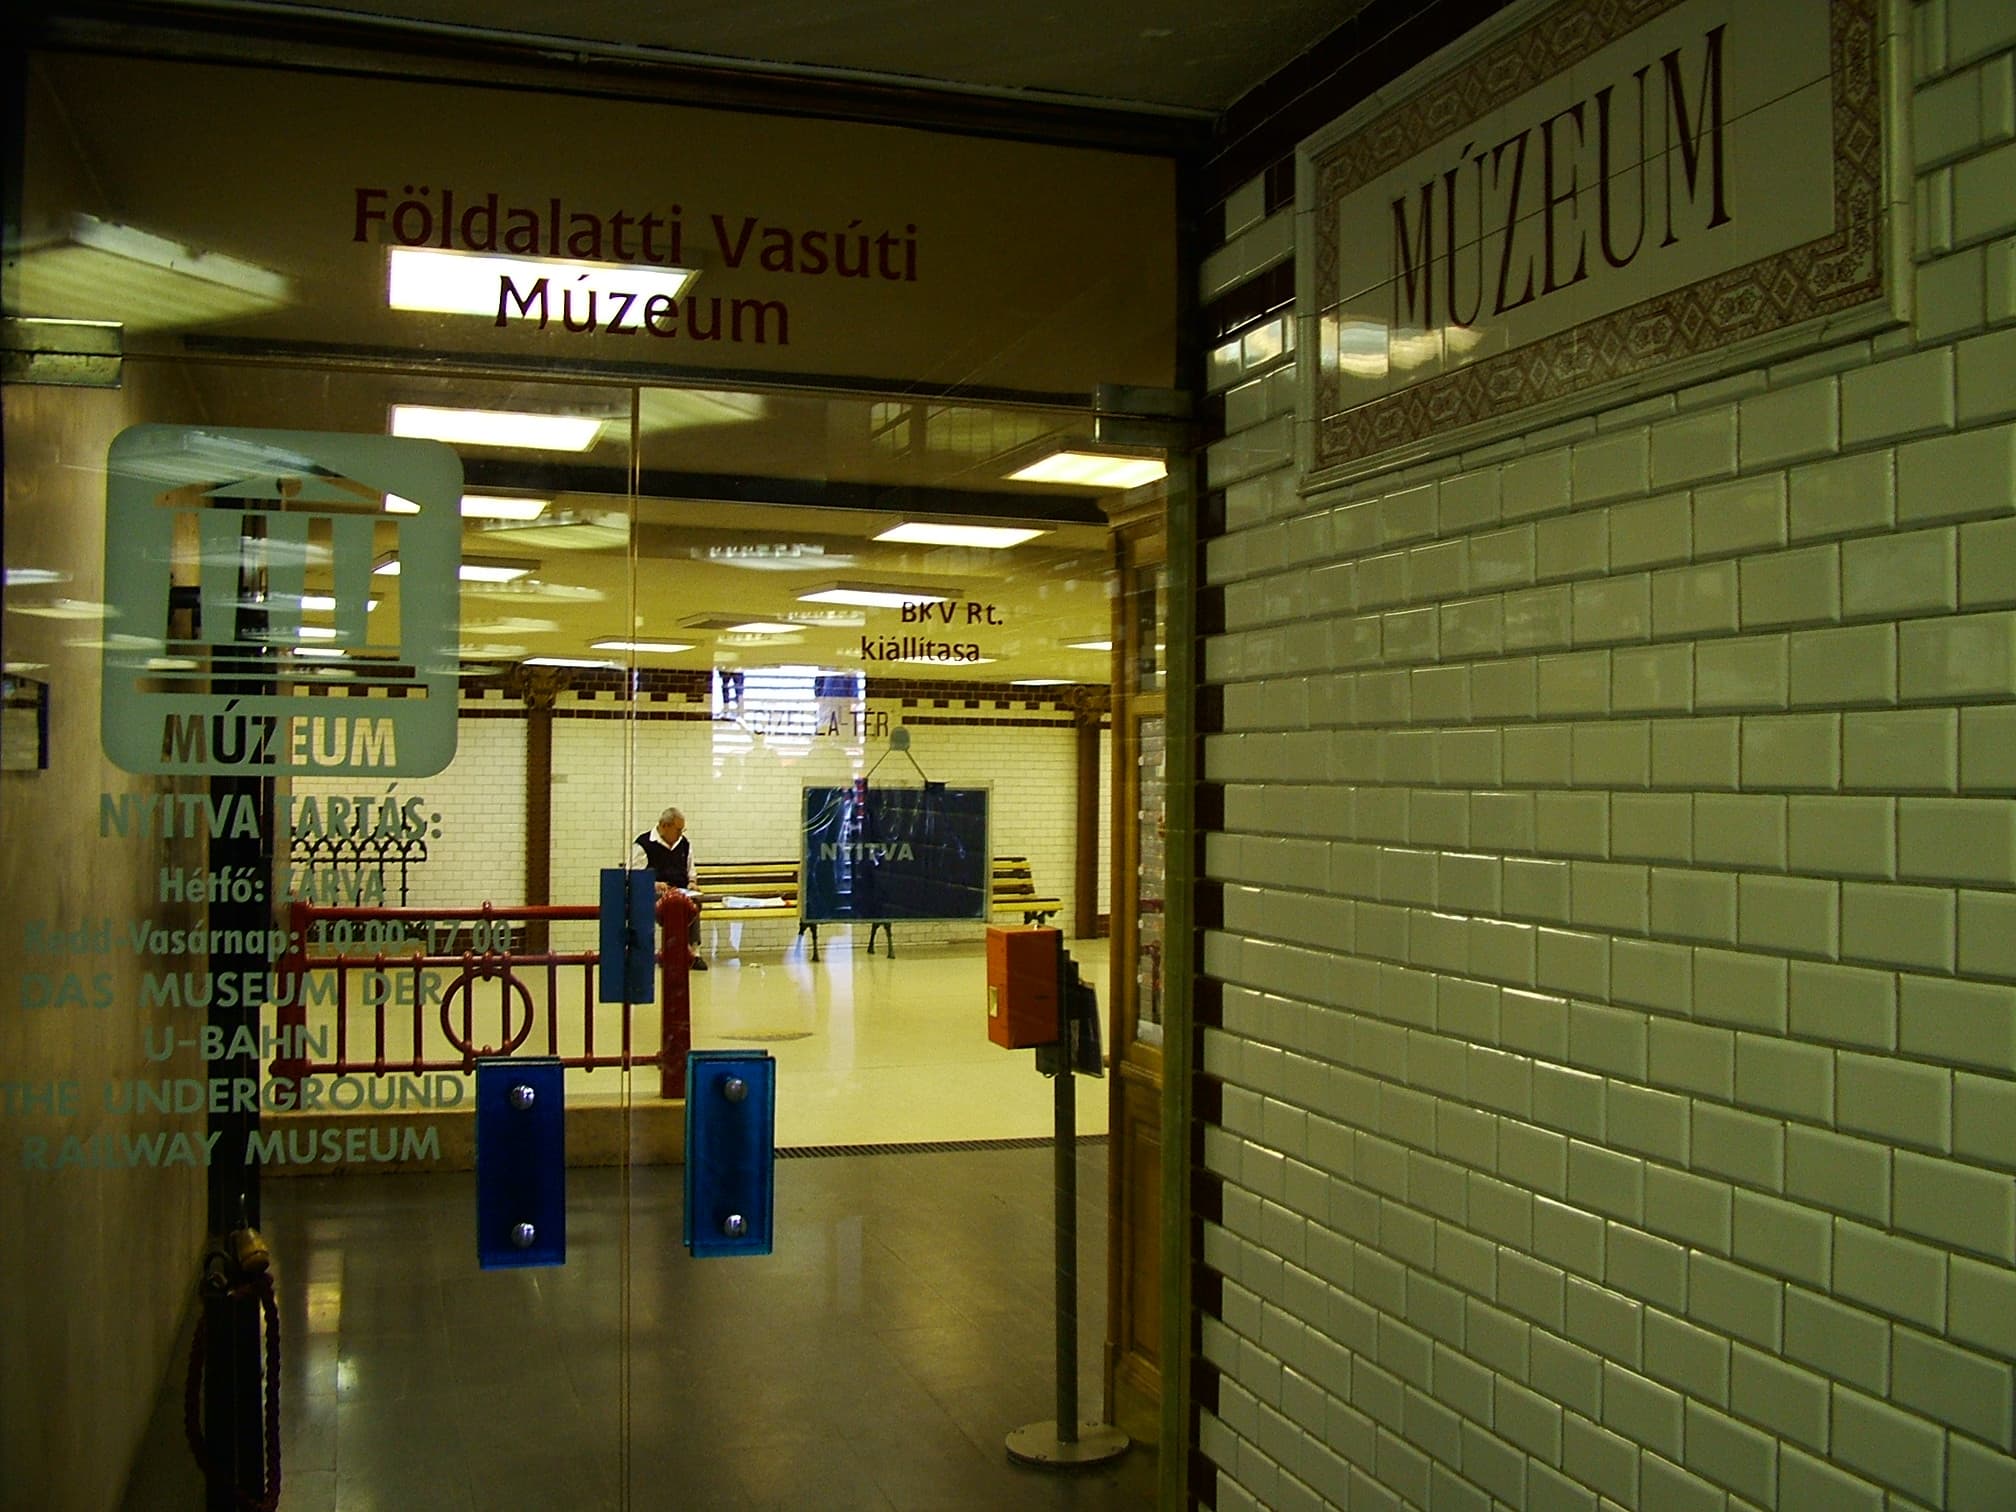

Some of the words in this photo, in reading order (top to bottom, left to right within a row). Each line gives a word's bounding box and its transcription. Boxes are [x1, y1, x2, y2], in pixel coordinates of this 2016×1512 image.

[1391, 23, 1732, 332] MÚZEUM
[352, 185, 682, 265] Földalatti
[711, 213, 918, 282] Vasúti
[494, 274, 790, 345] Múzeum
[902, 601, 957, 624] BKV
[967, 602, 1004, 625] Rt.
[160, 699, 398, 768] MÚZEUM
[100, 793, 260, 840] NYITVA
[276, 783, 443, 839] TARTÁS:
[820, 842, 915, 862] NYITVA
[159, 868, 264, 903] Hétfő:
[277, 856, 385, 903] ZÁRVA
[21, 974, 113, 1009] DAS
[138, 972, 338, 1008] MUSEUM
[362, 972, 444, 1006] DER
[143, 1025, 328, 1062] U-BAHN
[1, 1082, 80, 1117] THE
[104, 1075, 464, 1115] UNDERGROUND
[21, 1131, 223, 1170] RAILWAY
[244, 1127, 441, 1166] MUSEUM
